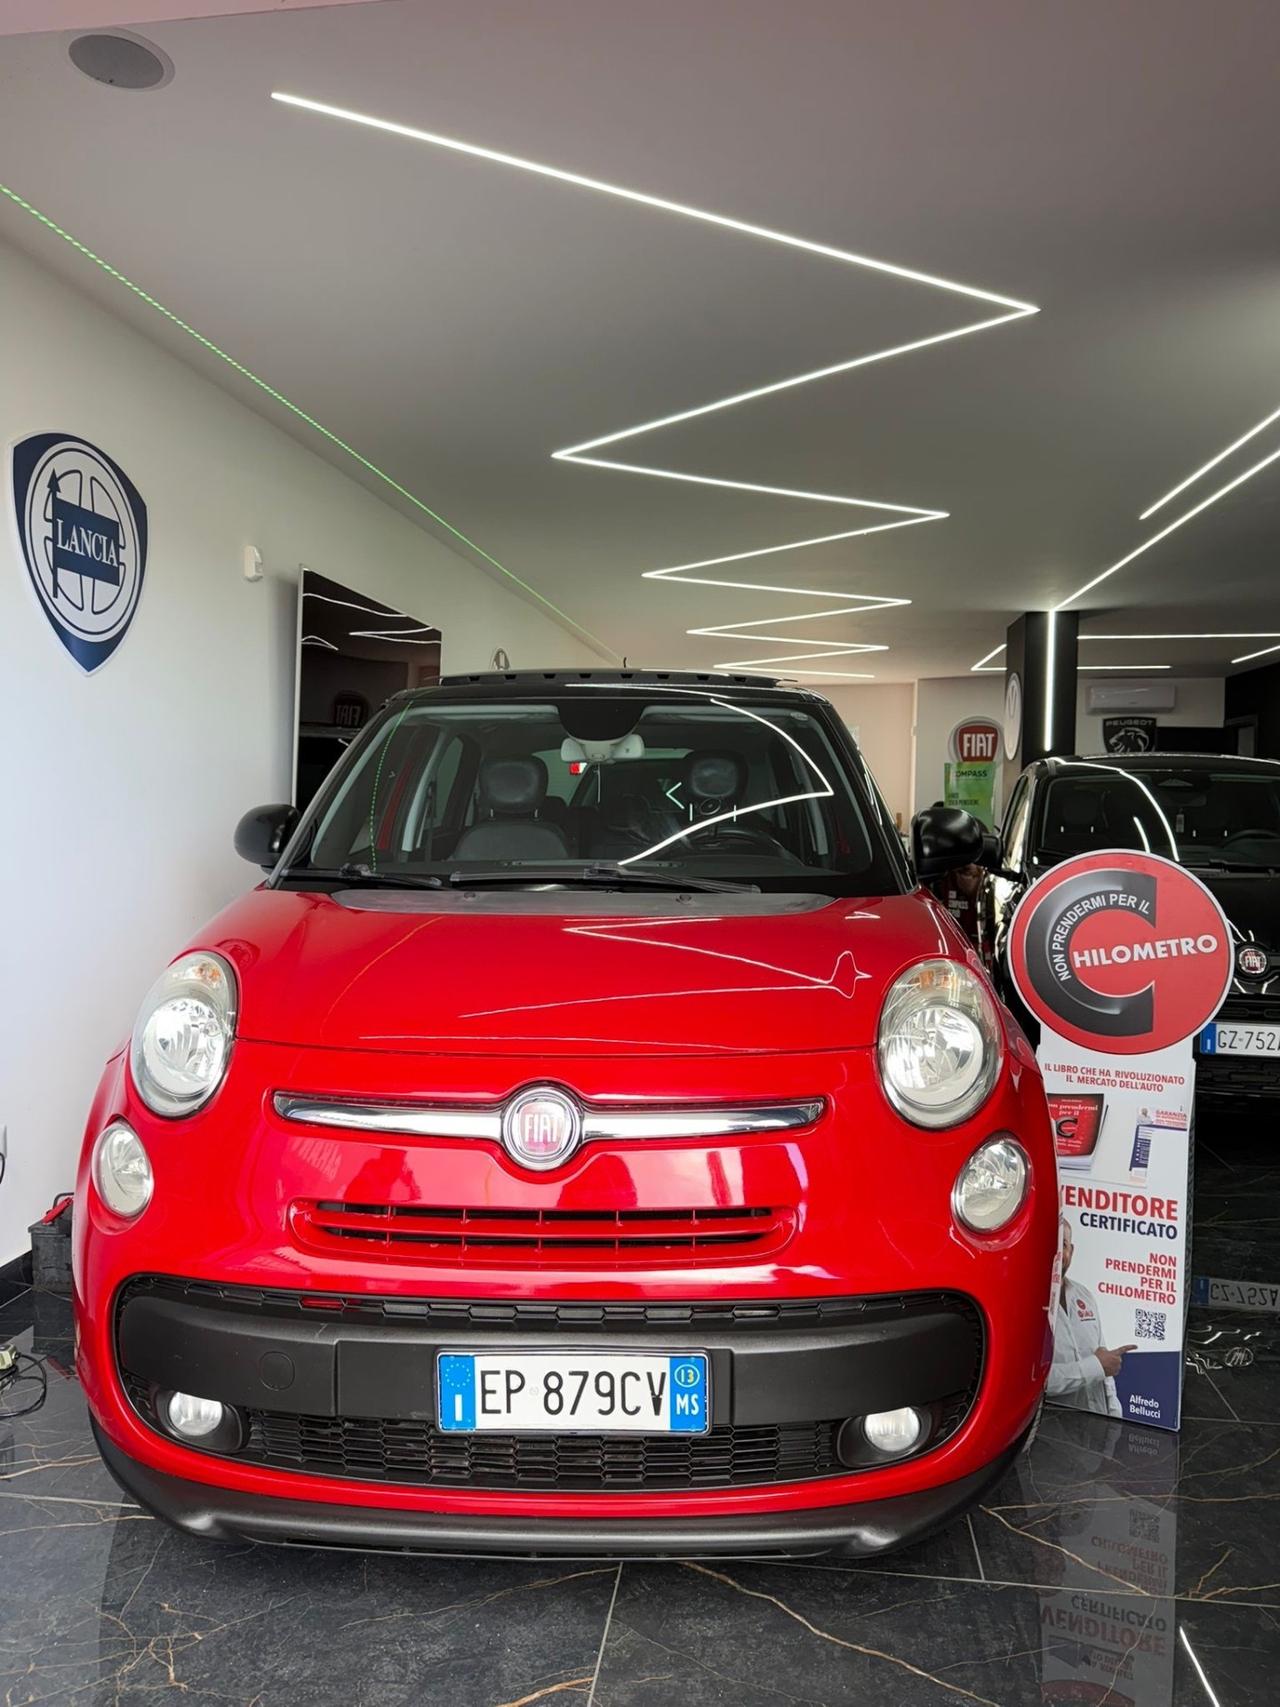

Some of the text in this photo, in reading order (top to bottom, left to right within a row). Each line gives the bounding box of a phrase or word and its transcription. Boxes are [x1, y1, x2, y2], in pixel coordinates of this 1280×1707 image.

[57, 518, 118, 567] LANCIA
[1105, 718, 1154, 727] PEUGEOT
[963, 733, 995, 757] FIAT
[1052, 893, 1150, 982] NON PRENDERMI PER IL
[1245, 955, 1261, 969] FIAT
[1244, 1031, 1280, 1051] 752
[1044, 1063, 1185, 1085] IL LIBRO CHE HA RIVOLUZIONATO
[1066, 1074, 1164, 1093] IL MERCATO DELL'AUTO
[524, 1113, 564, 1143] FIAT
[1061, 1185, 1178, 1221] ENDITORE
[1080, 1212, 1178, 1240] CERTIFICATO
[1105, 1258, 1177, 1280] PRENDERMI
[1149, 1252, 1177, 1267] NON
[1098, 1282, 1176, 1305] CHILOMETRO
[1140, 1276, 1177, 1292] PER IL
[680, 1368, 695, 1382] 13
[480, 1369, 526, 1414] EP
[1129, 1394, 1159, 1409] Alfredo
[676, 1393, 699, 1416] MS
[1129, 1405, 1161, 1419] Bellucci
